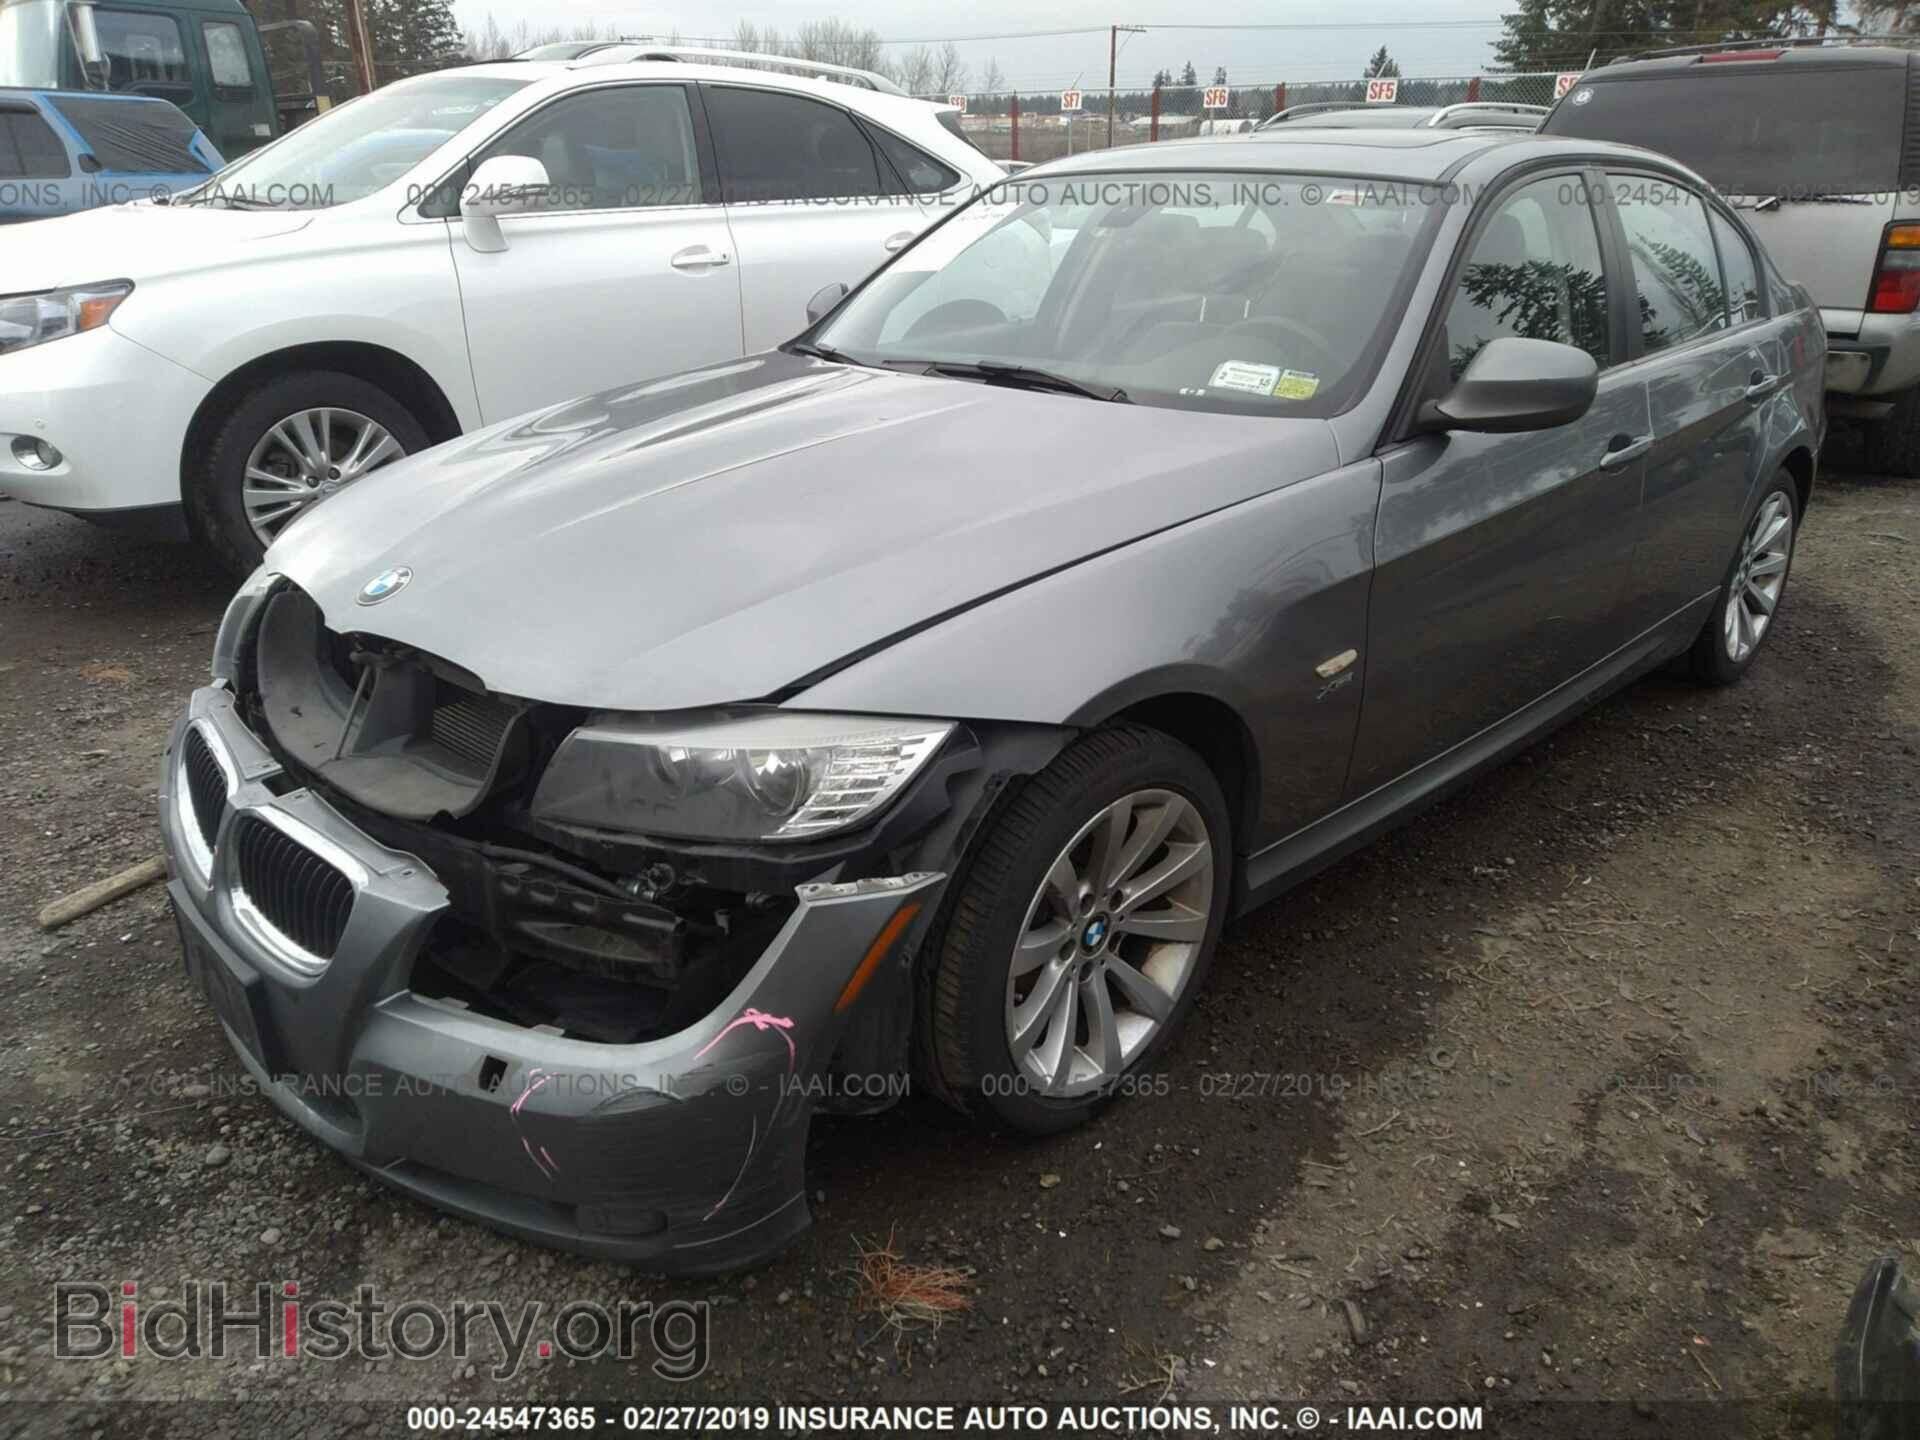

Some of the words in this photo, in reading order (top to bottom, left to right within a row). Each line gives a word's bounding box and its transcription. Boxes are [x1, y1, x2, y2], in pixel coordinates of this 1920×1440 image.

[1206, 89, 1226, 105] SF6
[1369, 82, 1395, 100] SF5
[1063, 92, 1080, 108] SF7
